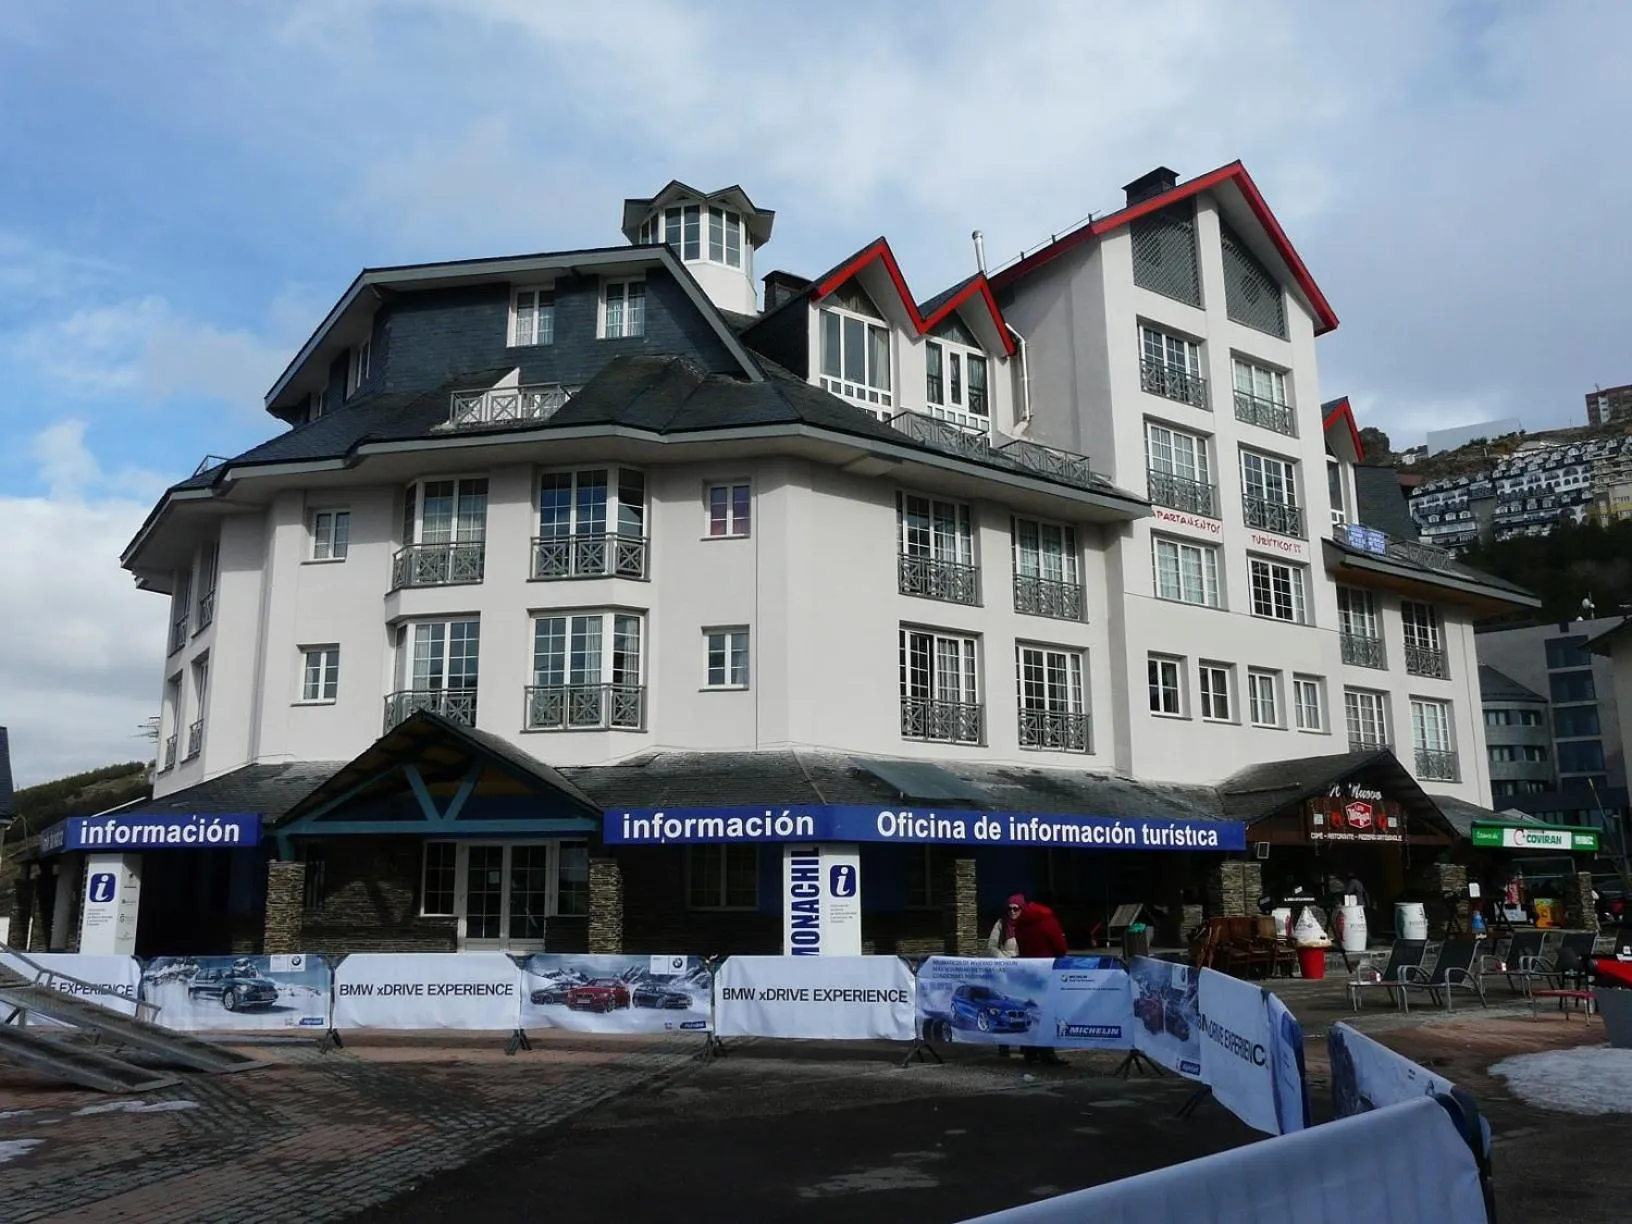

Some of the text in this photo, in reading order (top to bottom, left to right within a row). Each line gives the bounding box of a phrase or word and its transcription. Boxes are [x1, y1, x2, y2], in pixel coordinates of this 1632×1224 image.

[79, 818, 241, 844] información
[623, 810, 815, 839] información
[877, 811, 1219, 846] Oficina de información turística
[1526, 834, 1562, 844] COVIRAN
[339, 984, 513, 996] BMW xDRIVE EXPERIENCE
[722, 988, 908, 1003] BMW xDRIVE EXPERIENCE
[1069, 1027, 1119, 1035] MICHELIN
[1224, 1029, 1269, 1069] EXPERIENC
